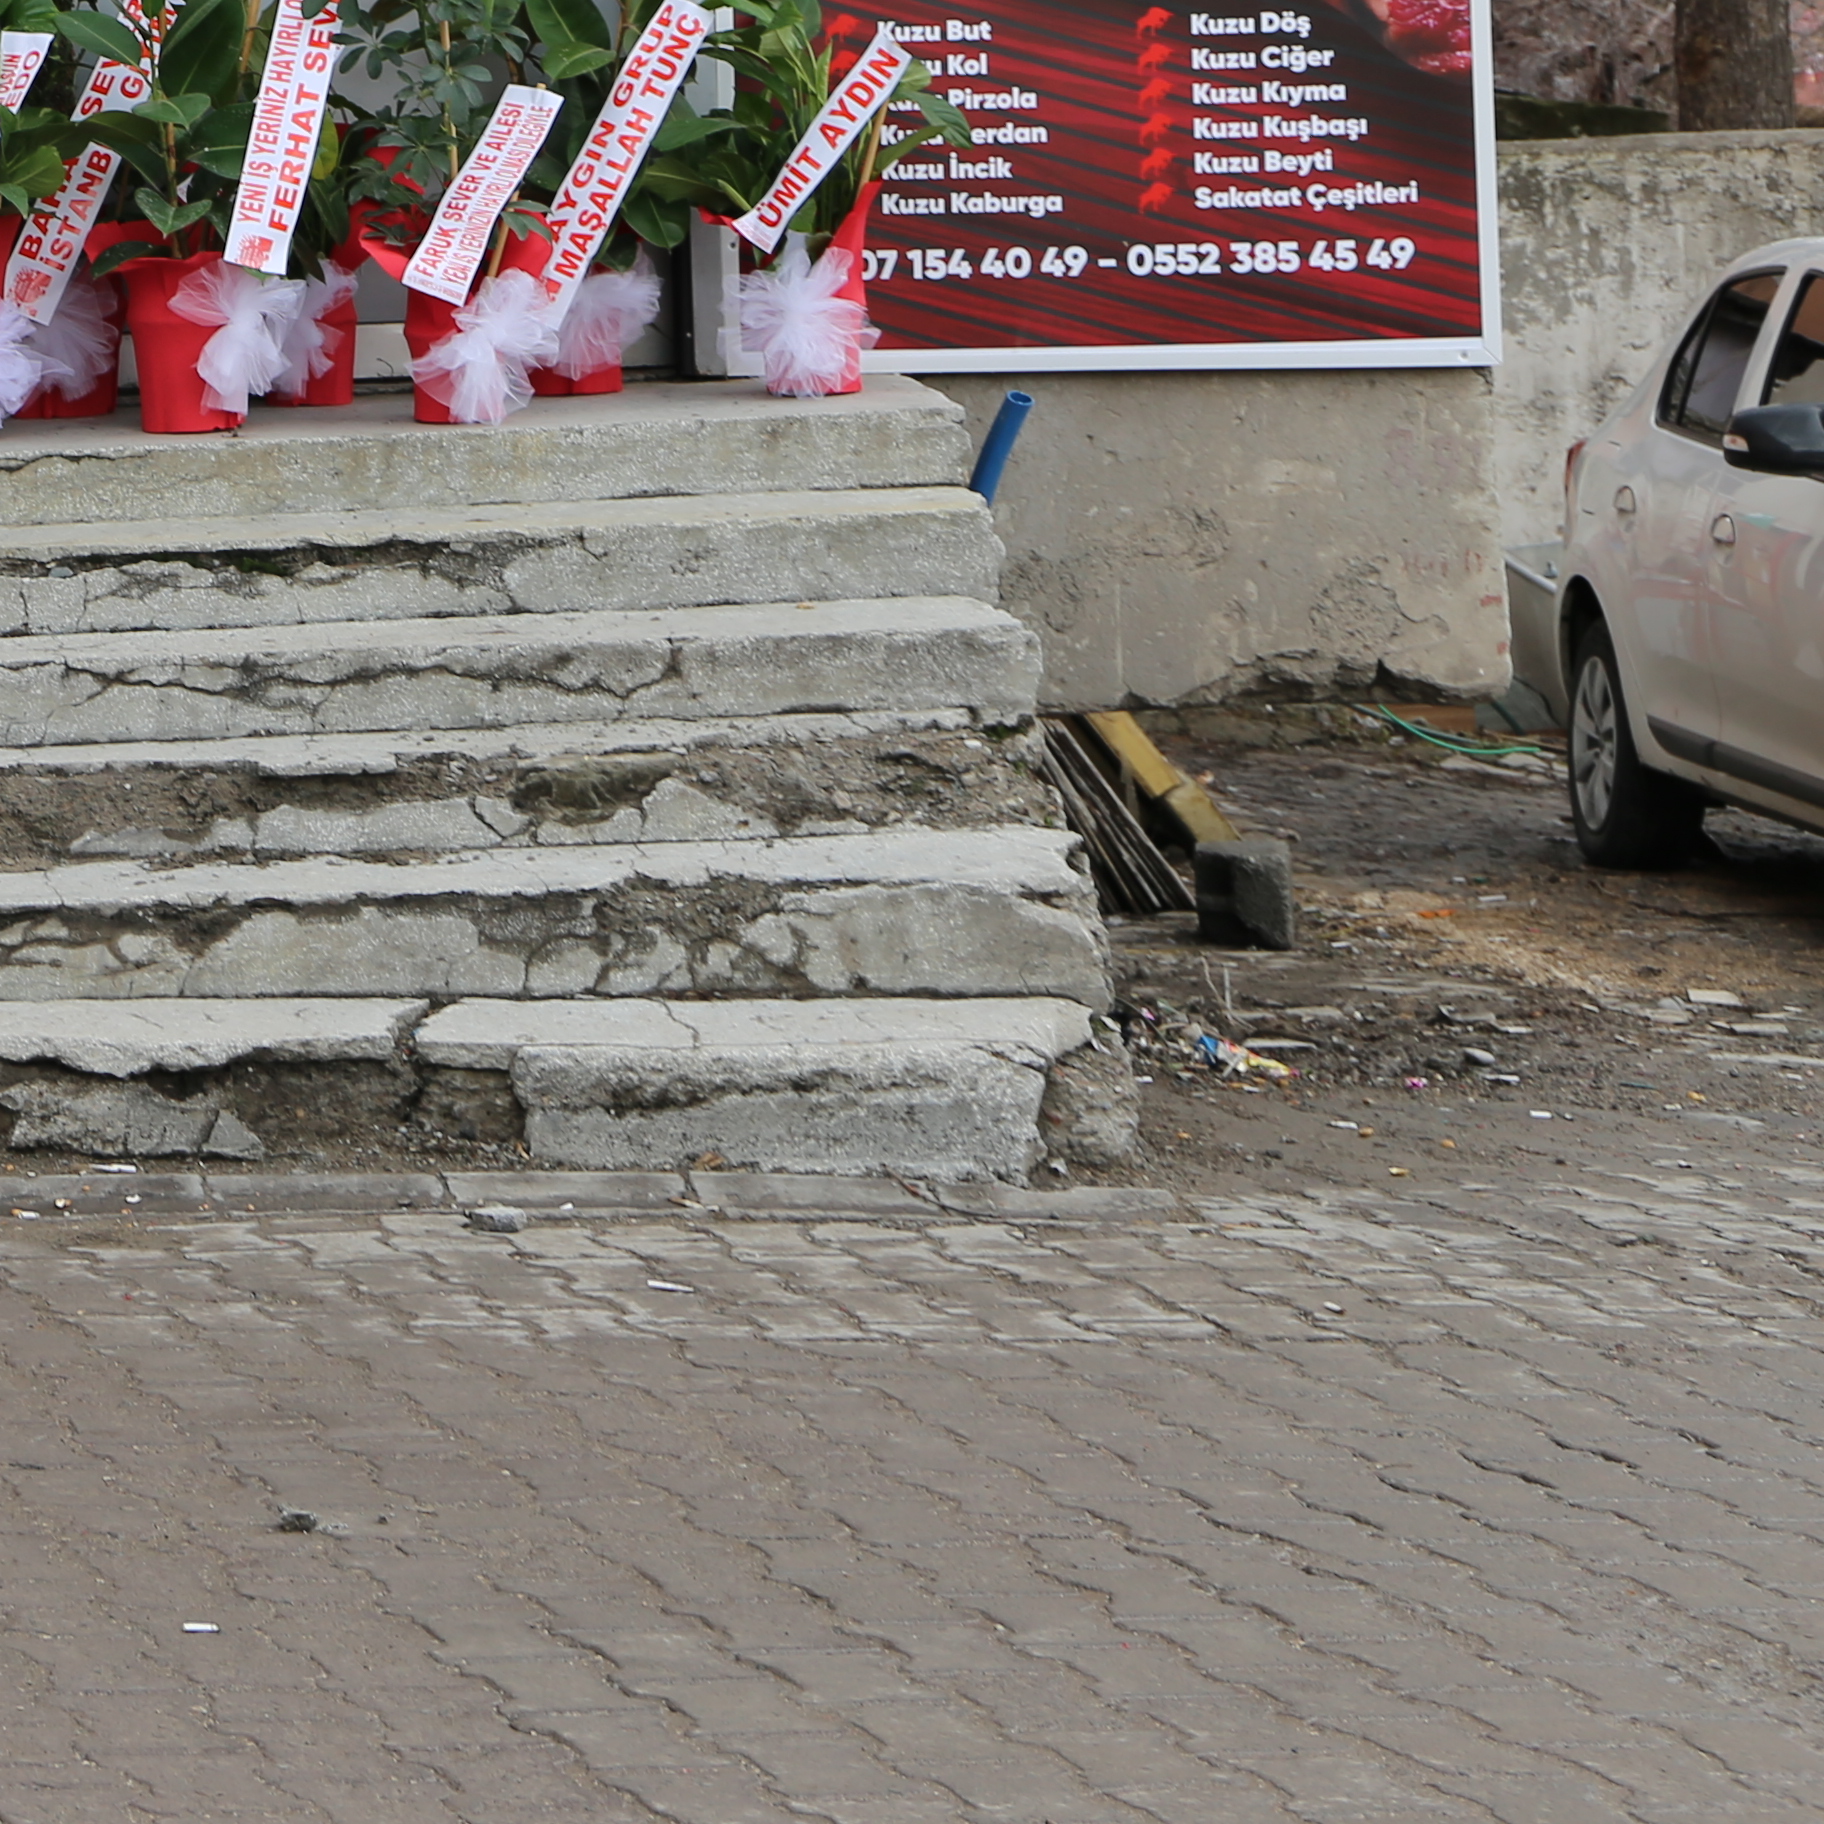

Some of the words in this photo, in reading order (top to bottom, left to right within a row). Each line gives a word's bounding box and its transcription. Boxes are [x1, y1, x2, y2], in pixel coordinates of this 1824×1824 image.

[877, 21, 941, 42] Kuzu
[946, 19, 992, 42] But
[1190, 12, 1255, 36] Kuzu
[1260, 8, 1312, 38] Döş
[268, 19, 303, 83] HAYIRLI
[614, 3, 675, 108] GRUP
[947, 53, 988, 76] Kol
[1191, 47, 1256, 71] Kuzu
[1260, 43, 1335, 72] Ciğer
[947, 86, 1038, 110] Pirzola
[1192, 82, 1257, 106] Kuzu
[1262, 78, 1347, 109] Kıyma
[253, 84, 290, 162] YERİNİZ
[756, 145, 823, 228] ÜMİT
[819, 47, 901, 150] AYDIN
[1193, 117, 1258, 141] Kuzu
[1263, 113, 1368, 145] Kuşbaşı
[268, 83, 320, 232] FERHAT
[554, 107, 654, 280] MAŞALLAH
[640, 12, 707, 99] TUNÇ
[242, 159, 279, 182] İŞ
[882, 158, 945, 181] Kuzu
[949, 151, 1014, 180] İncik
[1194, 151, 1259, 175] Kuzu
[1264, 147, 1335, 178] Beyti
[236, 180, 266, 224] YENİ
[881, 193, 945, 216] Kuzu
[950, 192, 1064, 218] Kaburga
[1195, 186, 1303, 210] Sakatat
[1306, 179, 1419, 212] Çeşitleri
[413, 221, 458, 279] FARUK
[441, 170, 485, 224] SEVER
[469, 149, 498, 177] VE
[906, 248, 973, 281] 154
[980, 247, 1033, 280] 40
[1040, 245, 1089, 278] 49
[1127, 242, 1221, 276] 0552
[1230, 240, 1301, 274] 385
[1309, 238, 1359, 272] 45
[1367, 235, 1417, 270] 49
